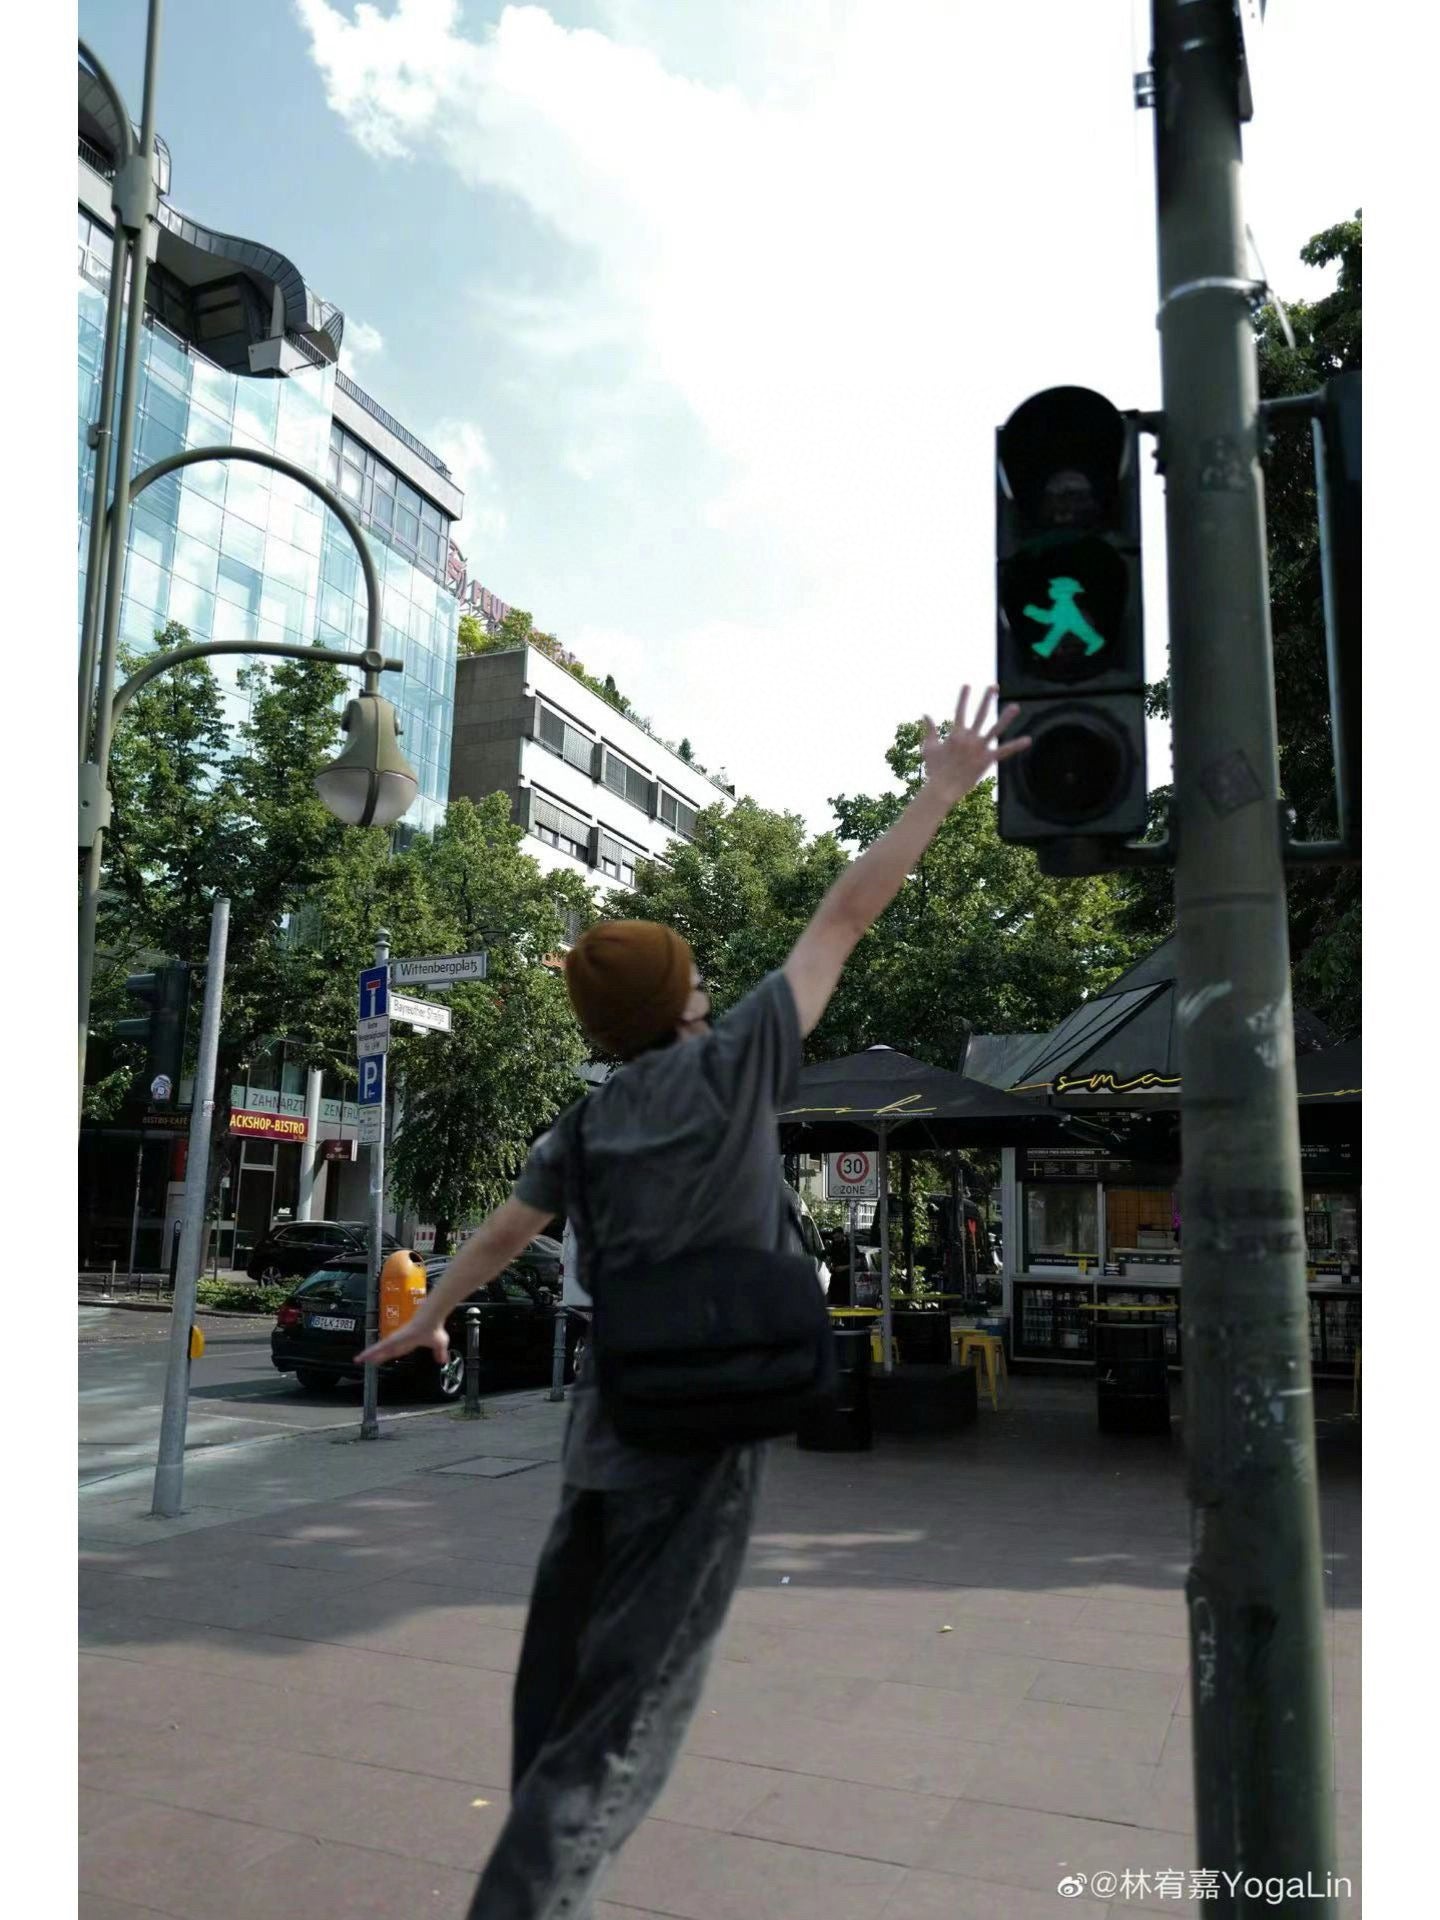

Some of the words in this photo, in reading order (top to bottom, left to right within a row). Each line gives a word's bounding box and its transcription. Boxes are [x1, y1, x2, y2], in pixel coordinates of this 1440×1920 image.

[400, 959, 478, 977] Wittenbergplatz
[363, 1061, 378, 1099] P
[252, 1093, 304, 1112] ZAHNARZT
[229, 1114, 305, 1135] ACKSHOP-BISTRO
[843, 1158, 862, 1174] 30
[839, 1185, 865, 1195] ZONE
